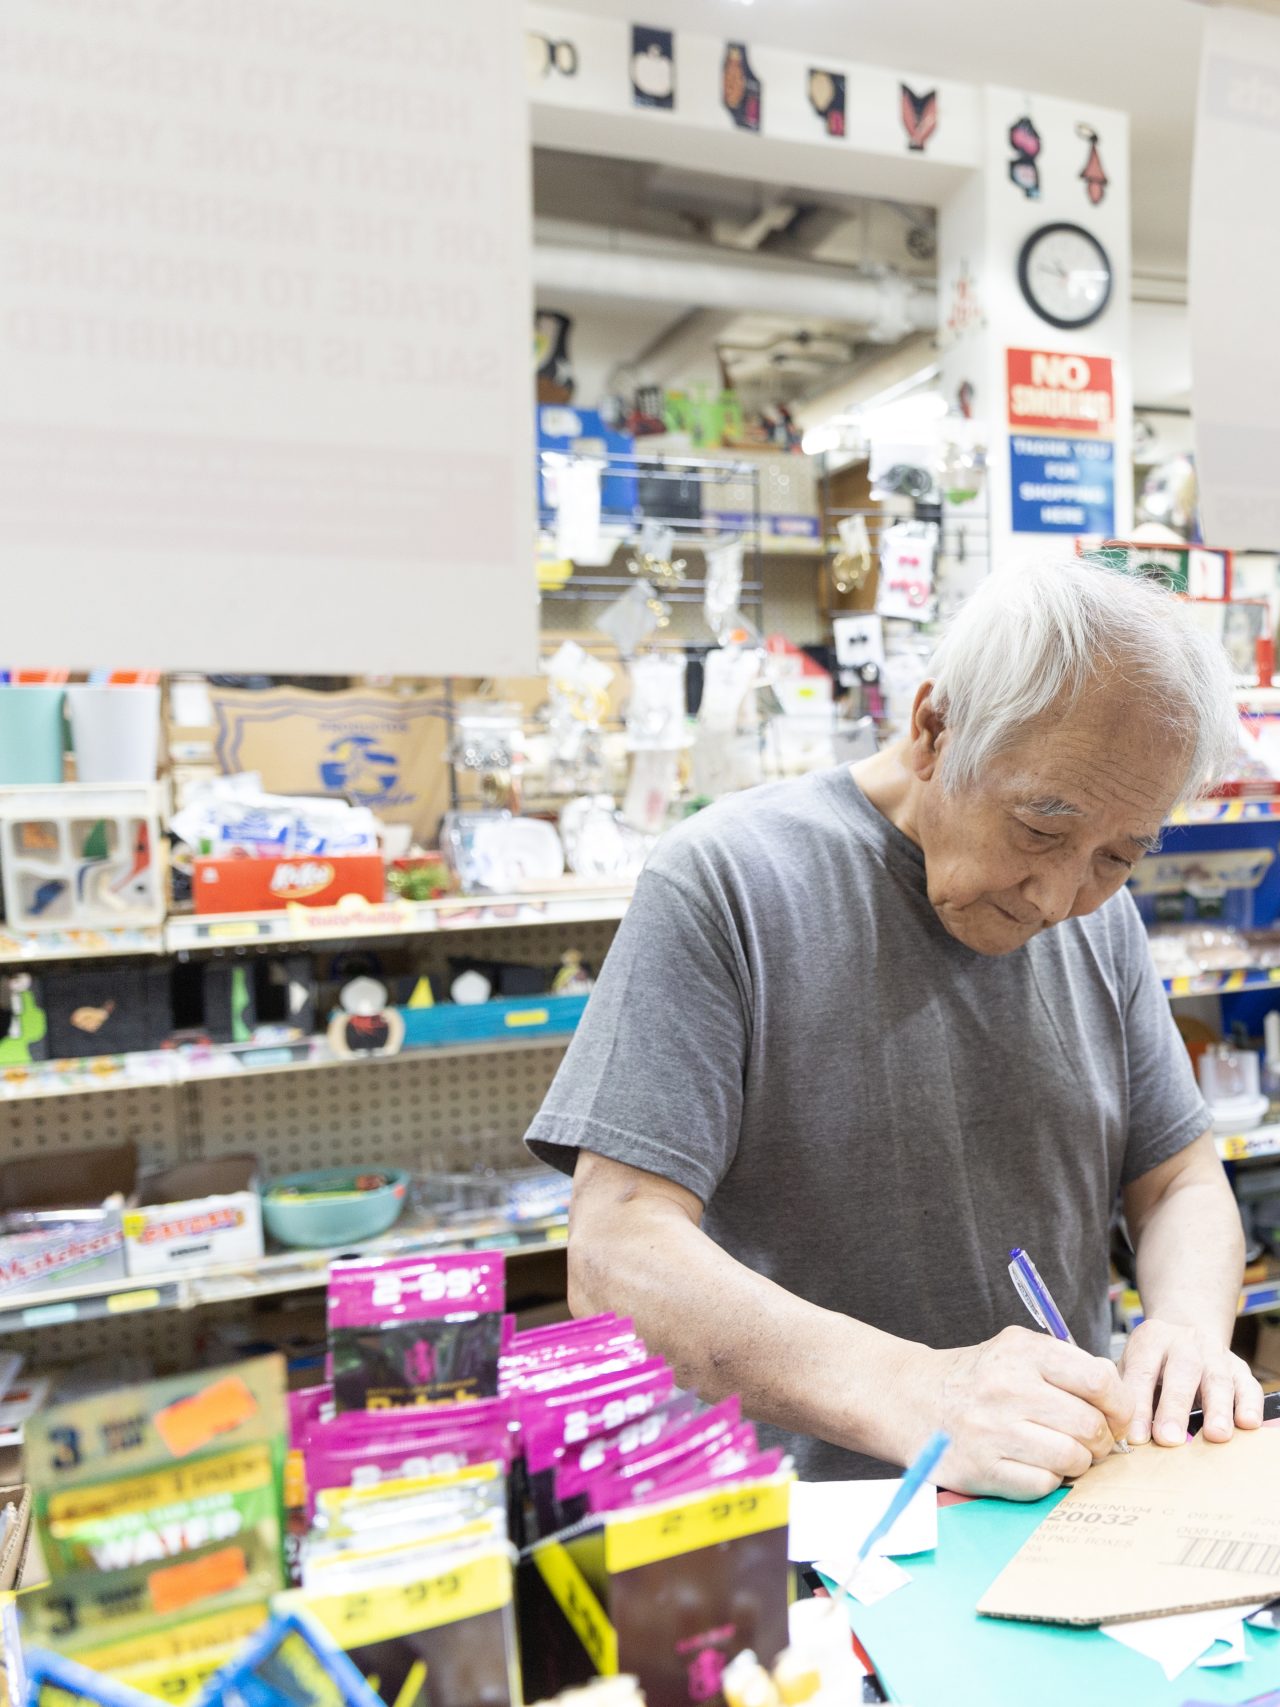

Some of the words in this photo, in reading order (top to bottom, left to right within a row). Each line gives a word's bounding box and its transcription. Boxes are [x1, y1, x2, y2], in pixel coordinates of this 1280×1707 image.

[1031, 353, 1091, 391] NO
[49, 1427, 81, 1470] 3
[1048, 1510, 1139, 1527] 20032
